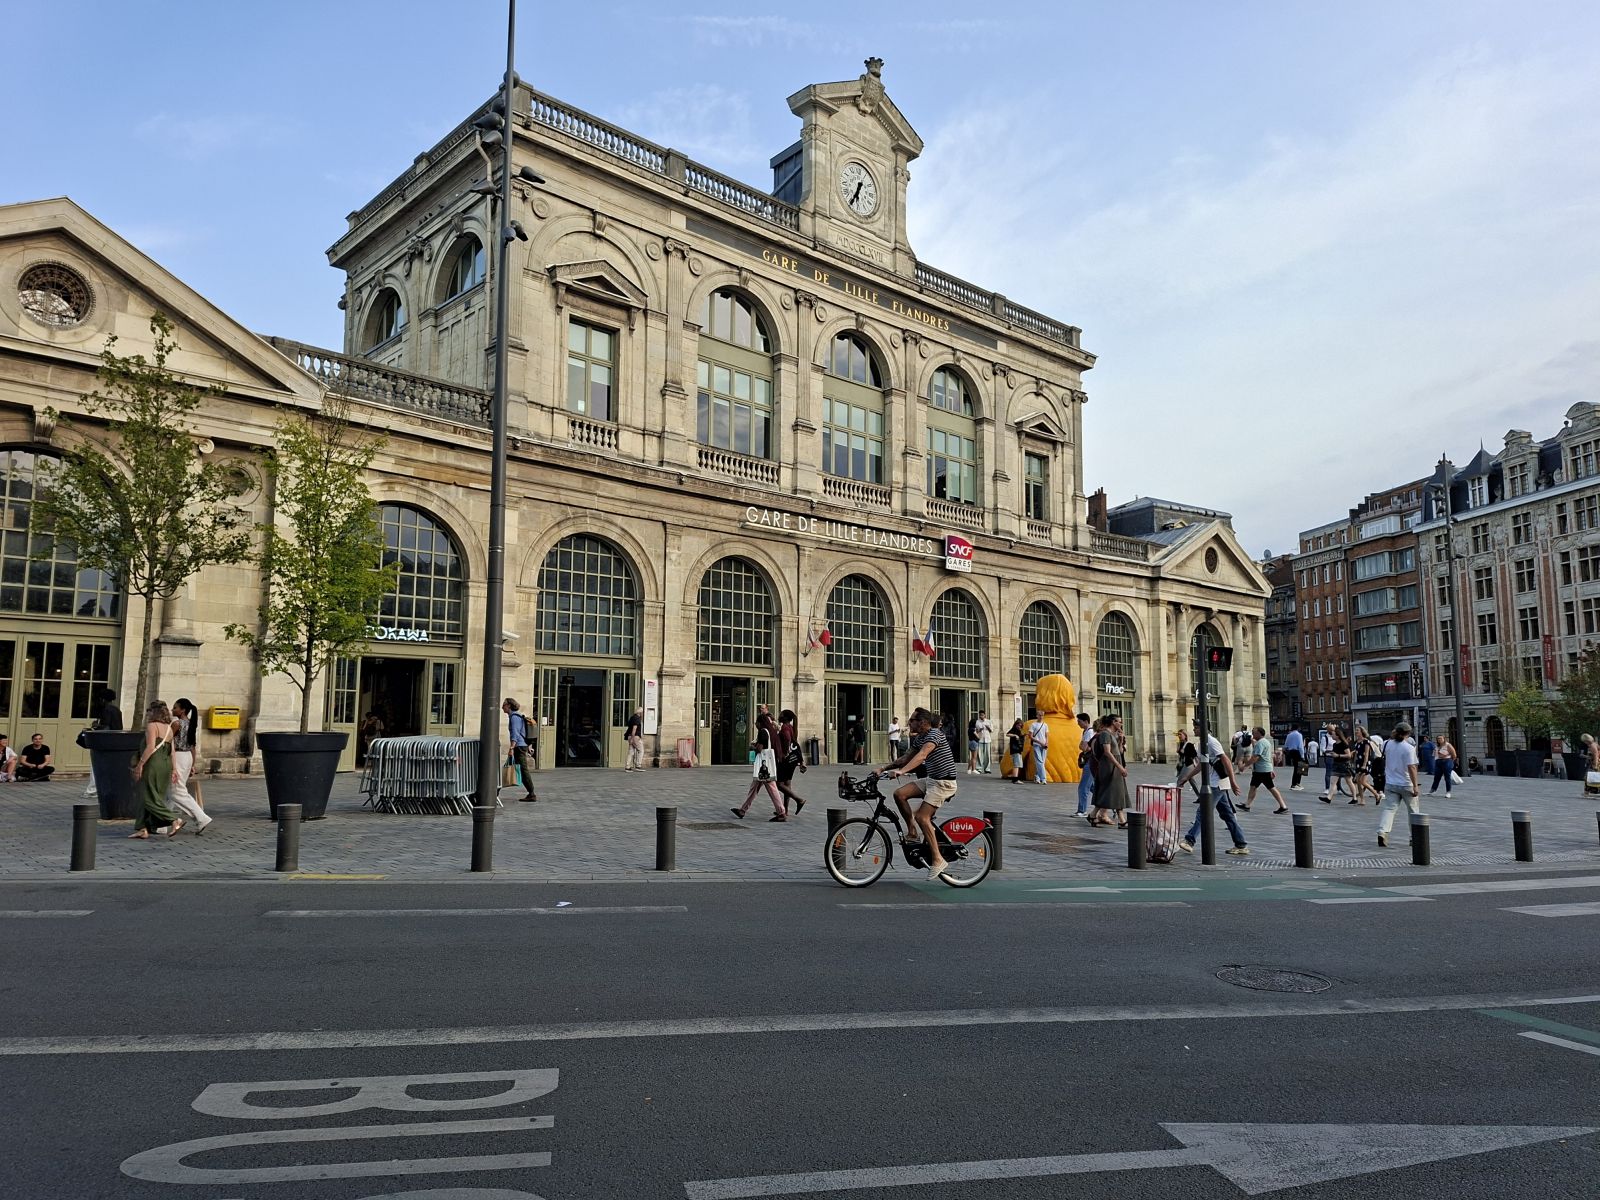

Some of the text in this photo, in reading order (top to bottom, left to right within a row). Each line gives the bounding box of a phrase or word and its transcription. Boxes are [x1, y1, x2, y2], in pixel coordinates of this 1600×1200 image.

[762, 249, 950, 331] GARE DE LILLE FLANDRES
[746, 506, 933, 554] GARE DE LILLE FLANDRES
[948, 543, 972, 557] SNCF
[947, 558, 971, 568] GARES
[1105, 682, 1125, 695] fnac
[1195, 688, 1211, 700] fc
[120, 1067, 560, 1200] BU
